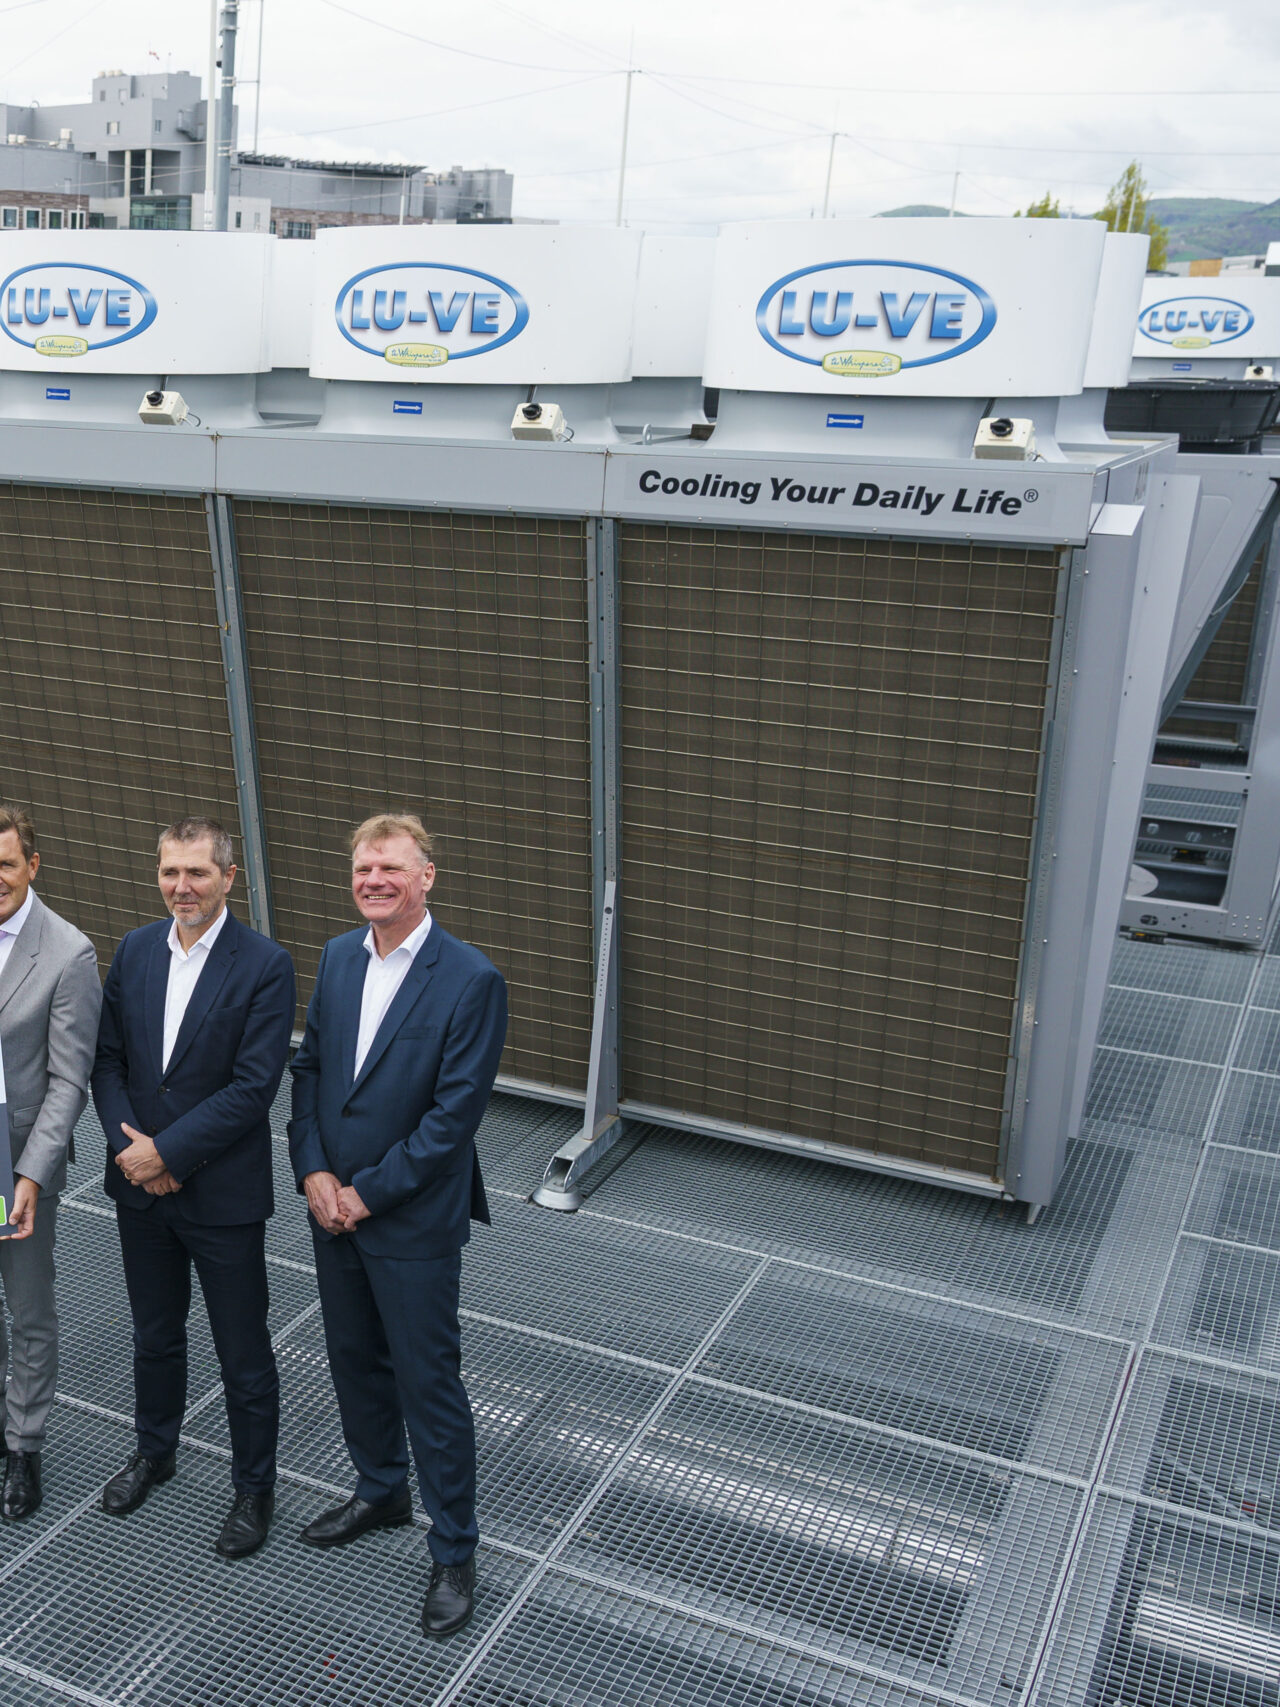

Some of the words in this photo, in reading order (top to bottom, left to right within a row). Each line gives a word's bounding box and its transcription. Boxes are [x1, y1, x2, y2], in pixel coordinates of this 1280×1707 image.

[7, 287, 132, 327] LU-VE
[350, 289, 502, 334] LU-VE
[778, 290, 968, 339] LU-VE
[1148, 310, 1242, 333] LU-VE
[639, 470, 762, 505] Cooling
[770, 477, 846, 504] Your
[852, 482, 945, 516] Daily
